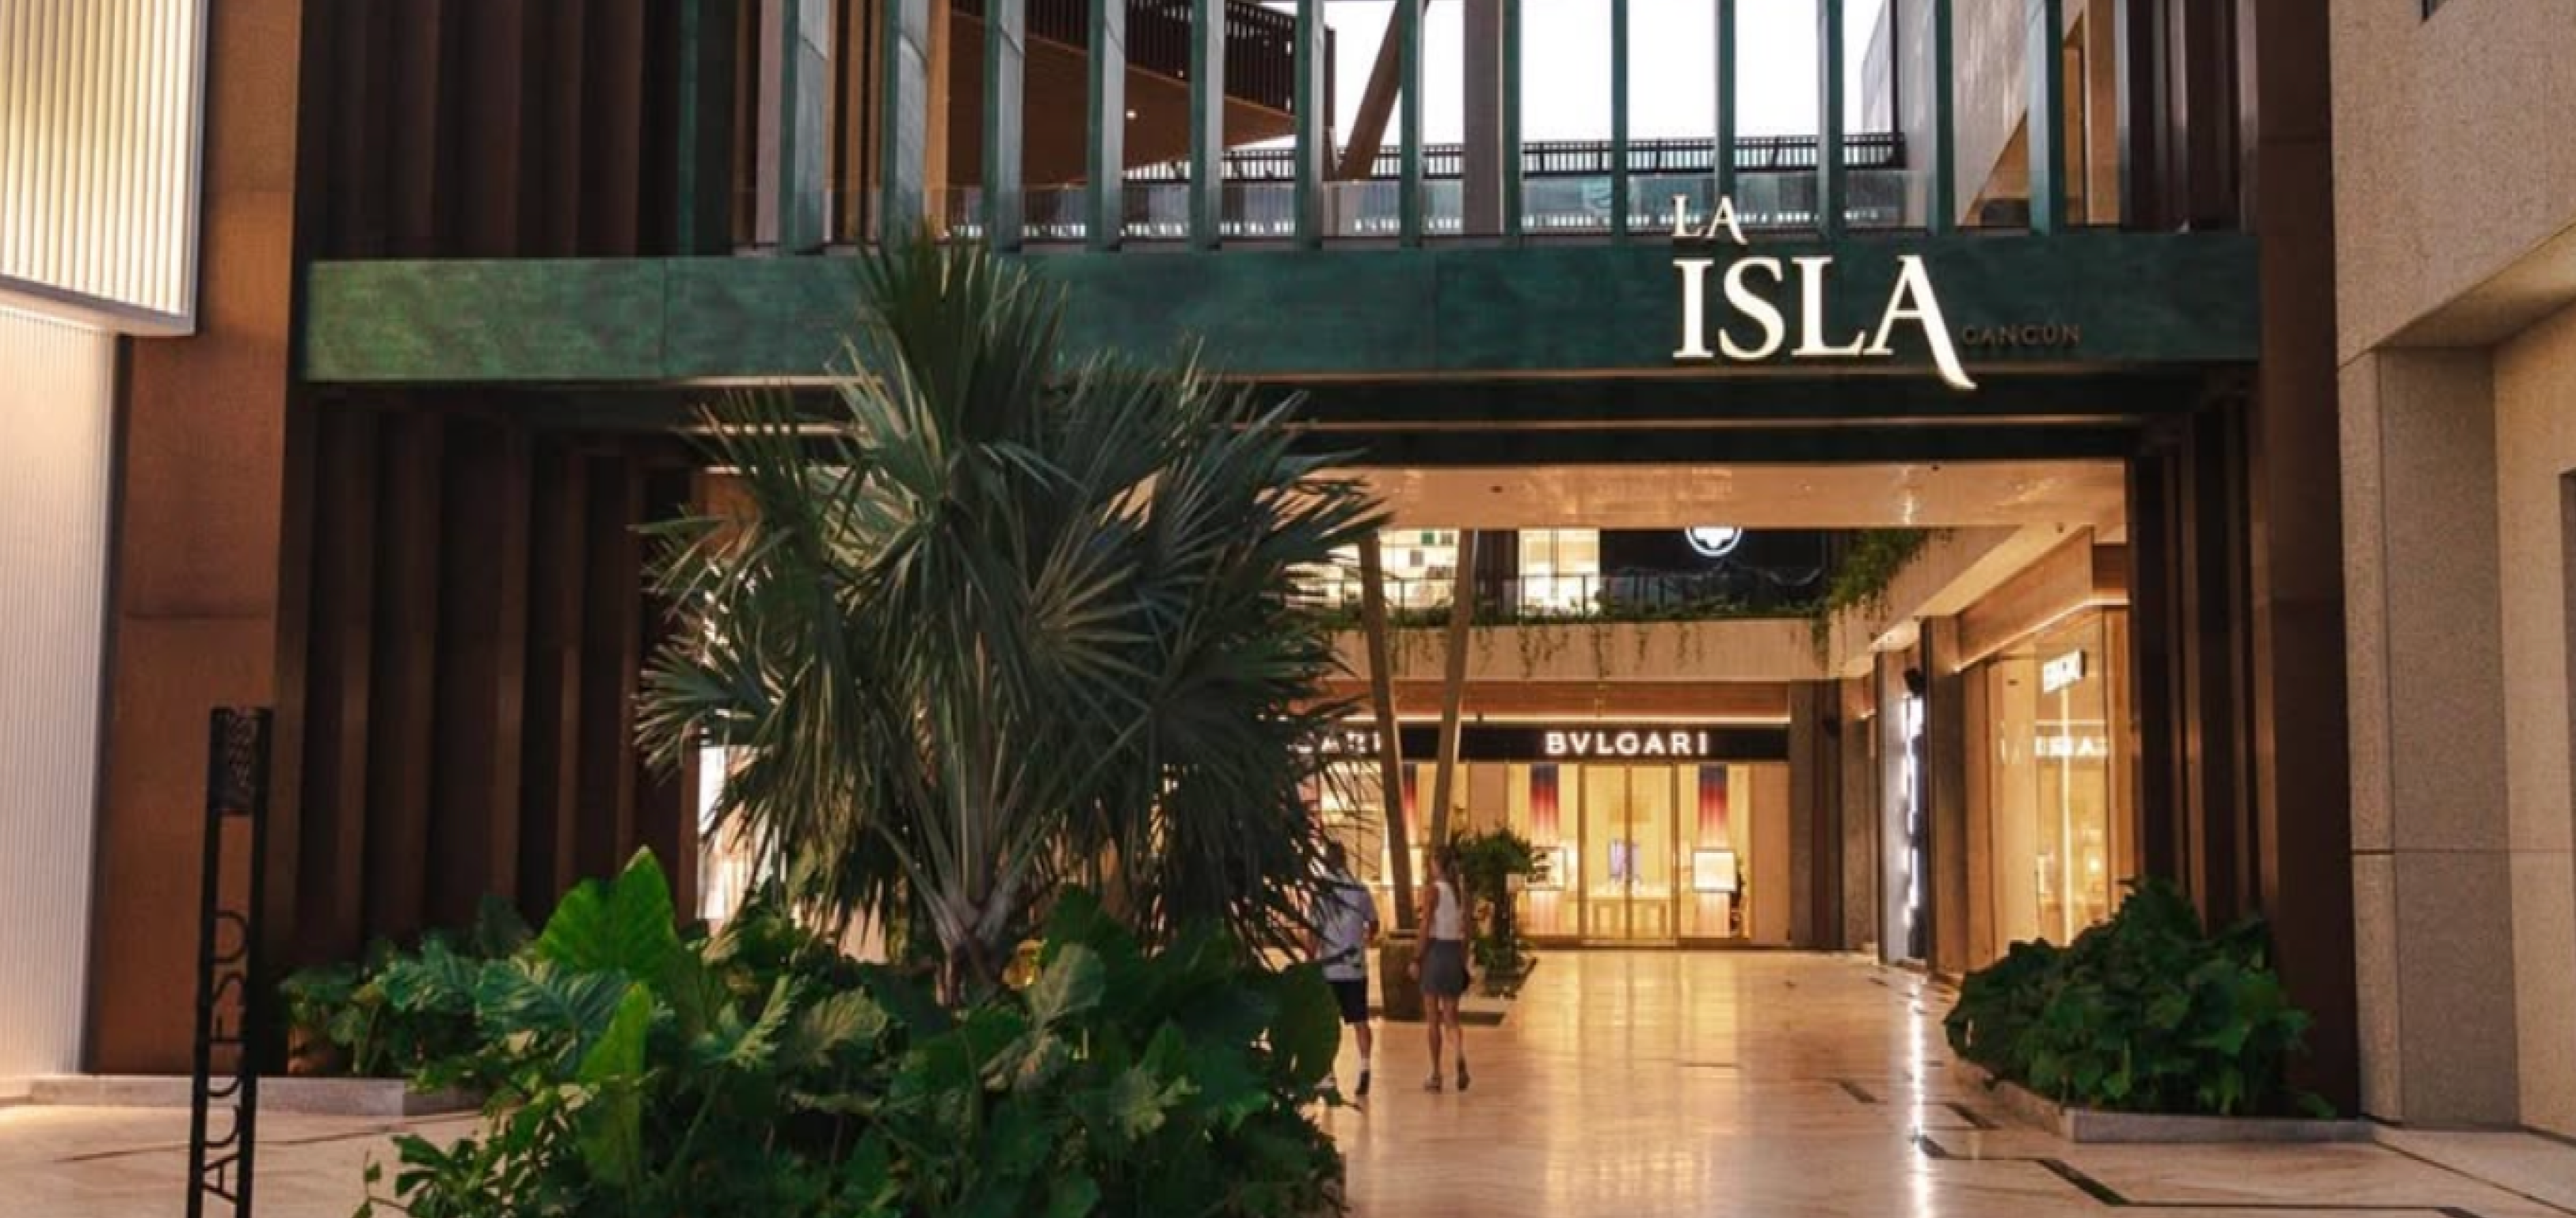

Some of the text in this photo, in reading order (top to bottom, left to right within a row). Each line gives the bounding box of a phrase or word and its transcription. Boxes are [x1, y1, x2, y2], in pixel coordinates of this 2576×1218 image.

[1671, 195, 1747, 245] LA
[1671, 255, 1976, 389] ISLA
[1545, 730, 1709, 756] BVLGARI
